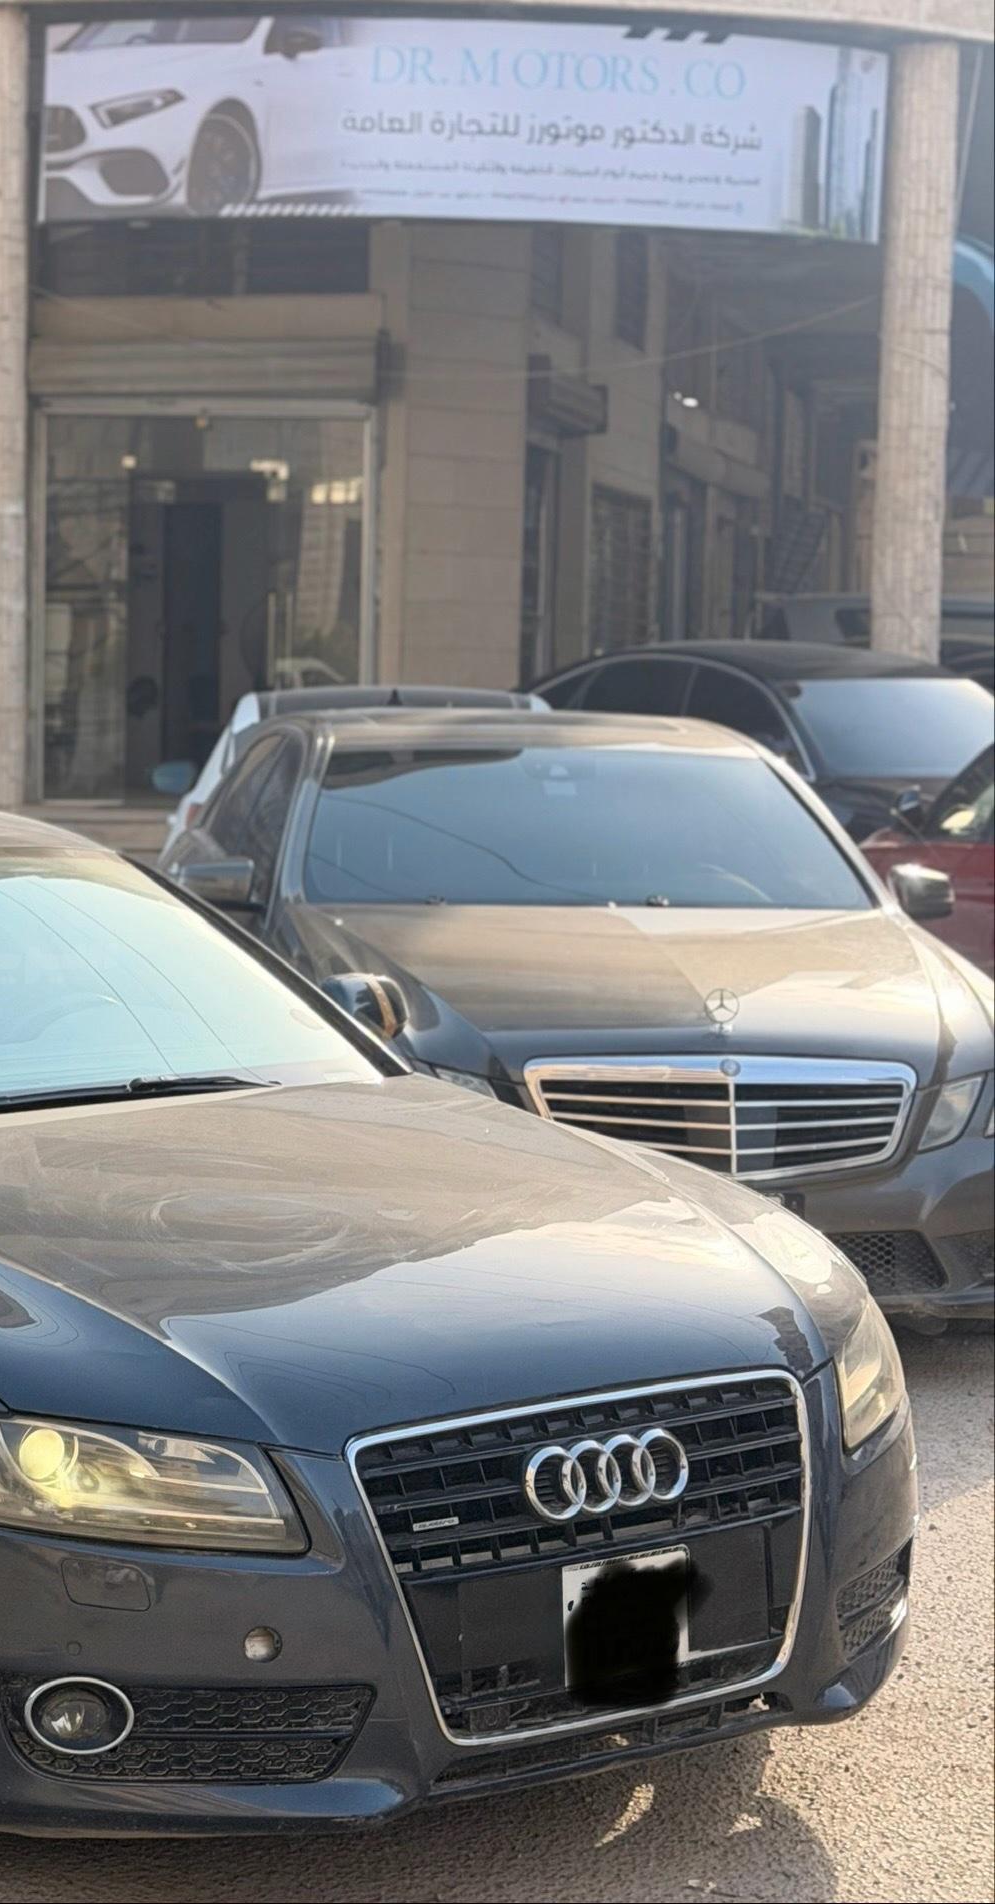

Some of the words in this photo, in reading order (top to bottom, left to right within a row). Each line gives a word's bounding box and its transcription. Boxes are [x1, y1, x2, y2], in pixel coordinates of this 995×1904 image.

[342, 109, 423, 135] العامة
[430, 111, 520, 142] للتجارة
[525, 114, 606, 146] موتورز
[613, 118, 696, 148] الدكتور
[700, 123, 763, 154] شركة
